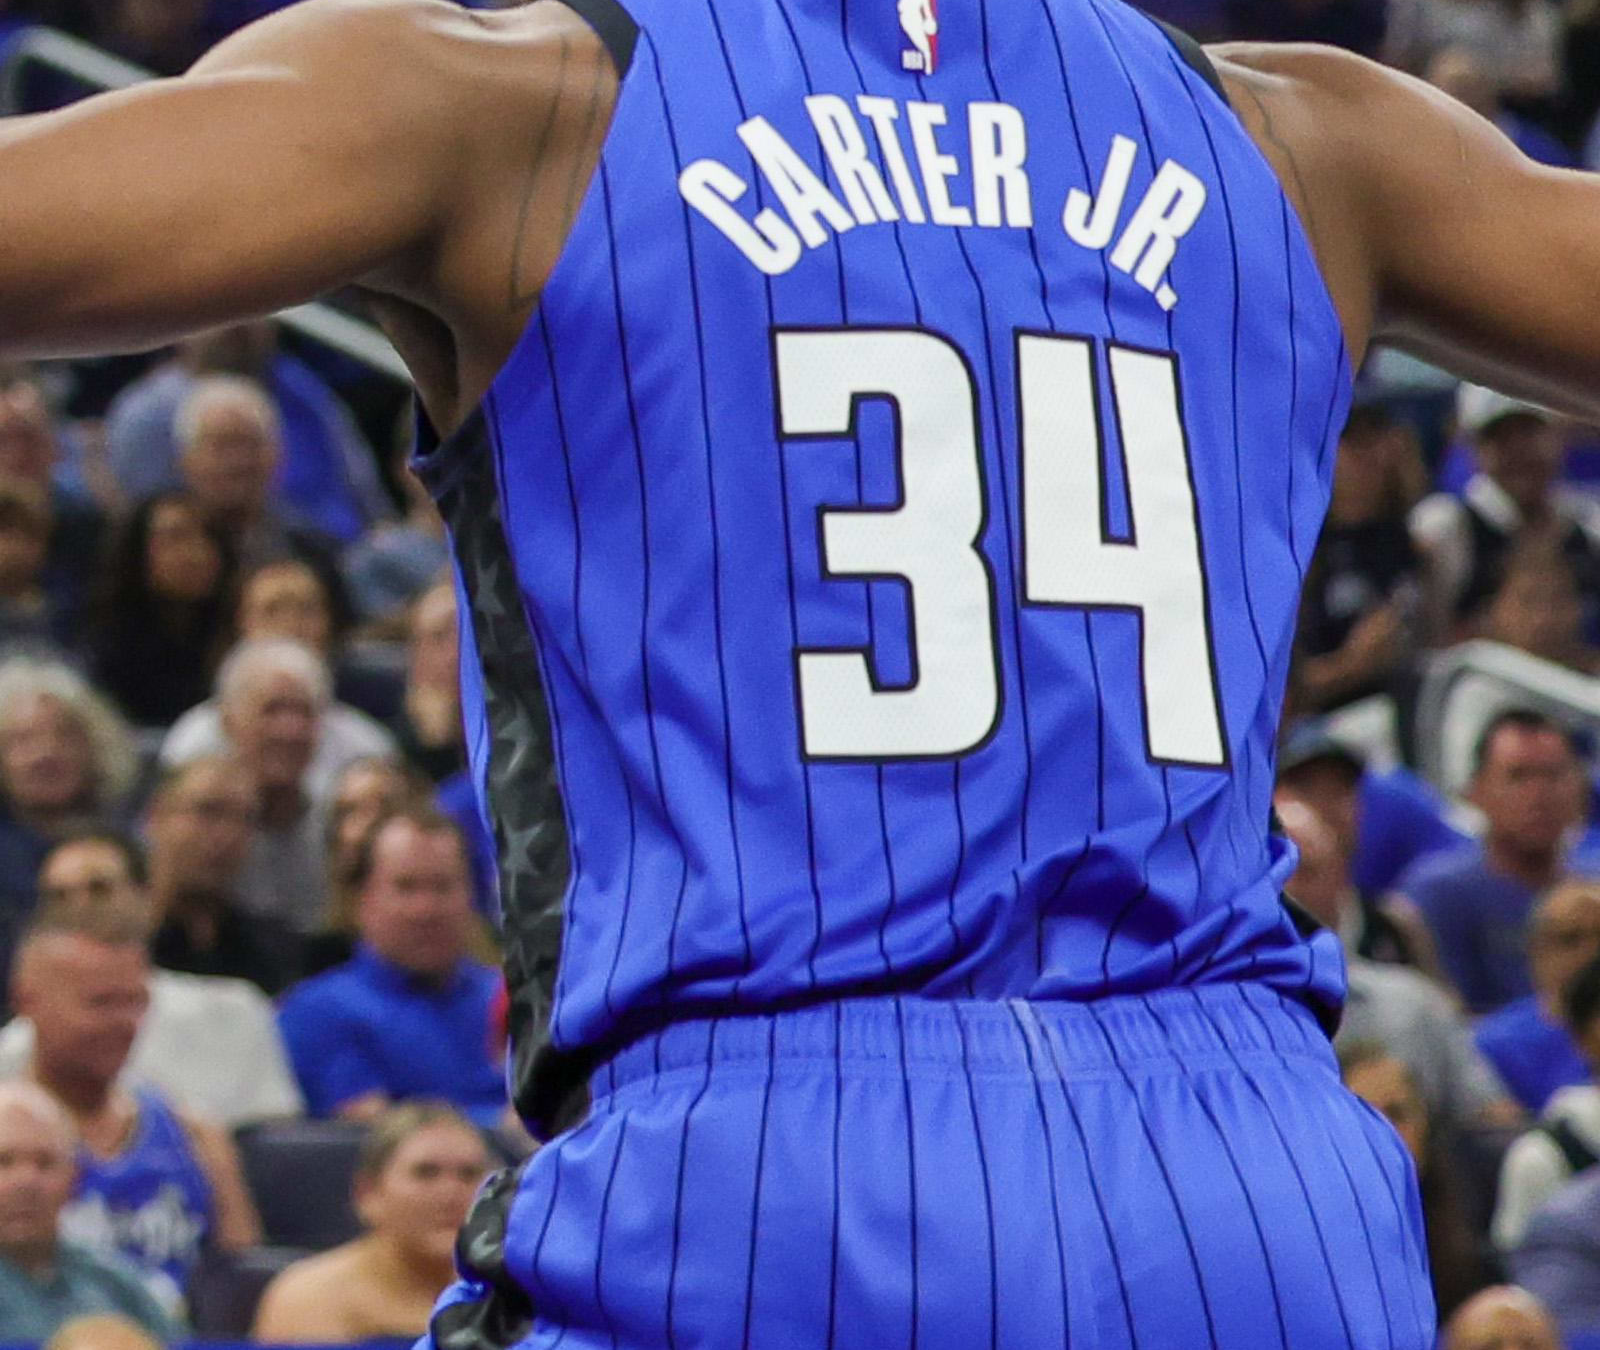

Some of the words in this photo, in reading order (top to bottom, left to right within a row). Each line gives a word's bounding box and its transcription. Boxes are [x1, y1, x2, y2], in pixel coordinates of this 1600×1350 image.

[677, 93, 1033, 275] CARTER
[1061, 133, 1208, 312] JR.
[769, 324, 1231, 767] 34
